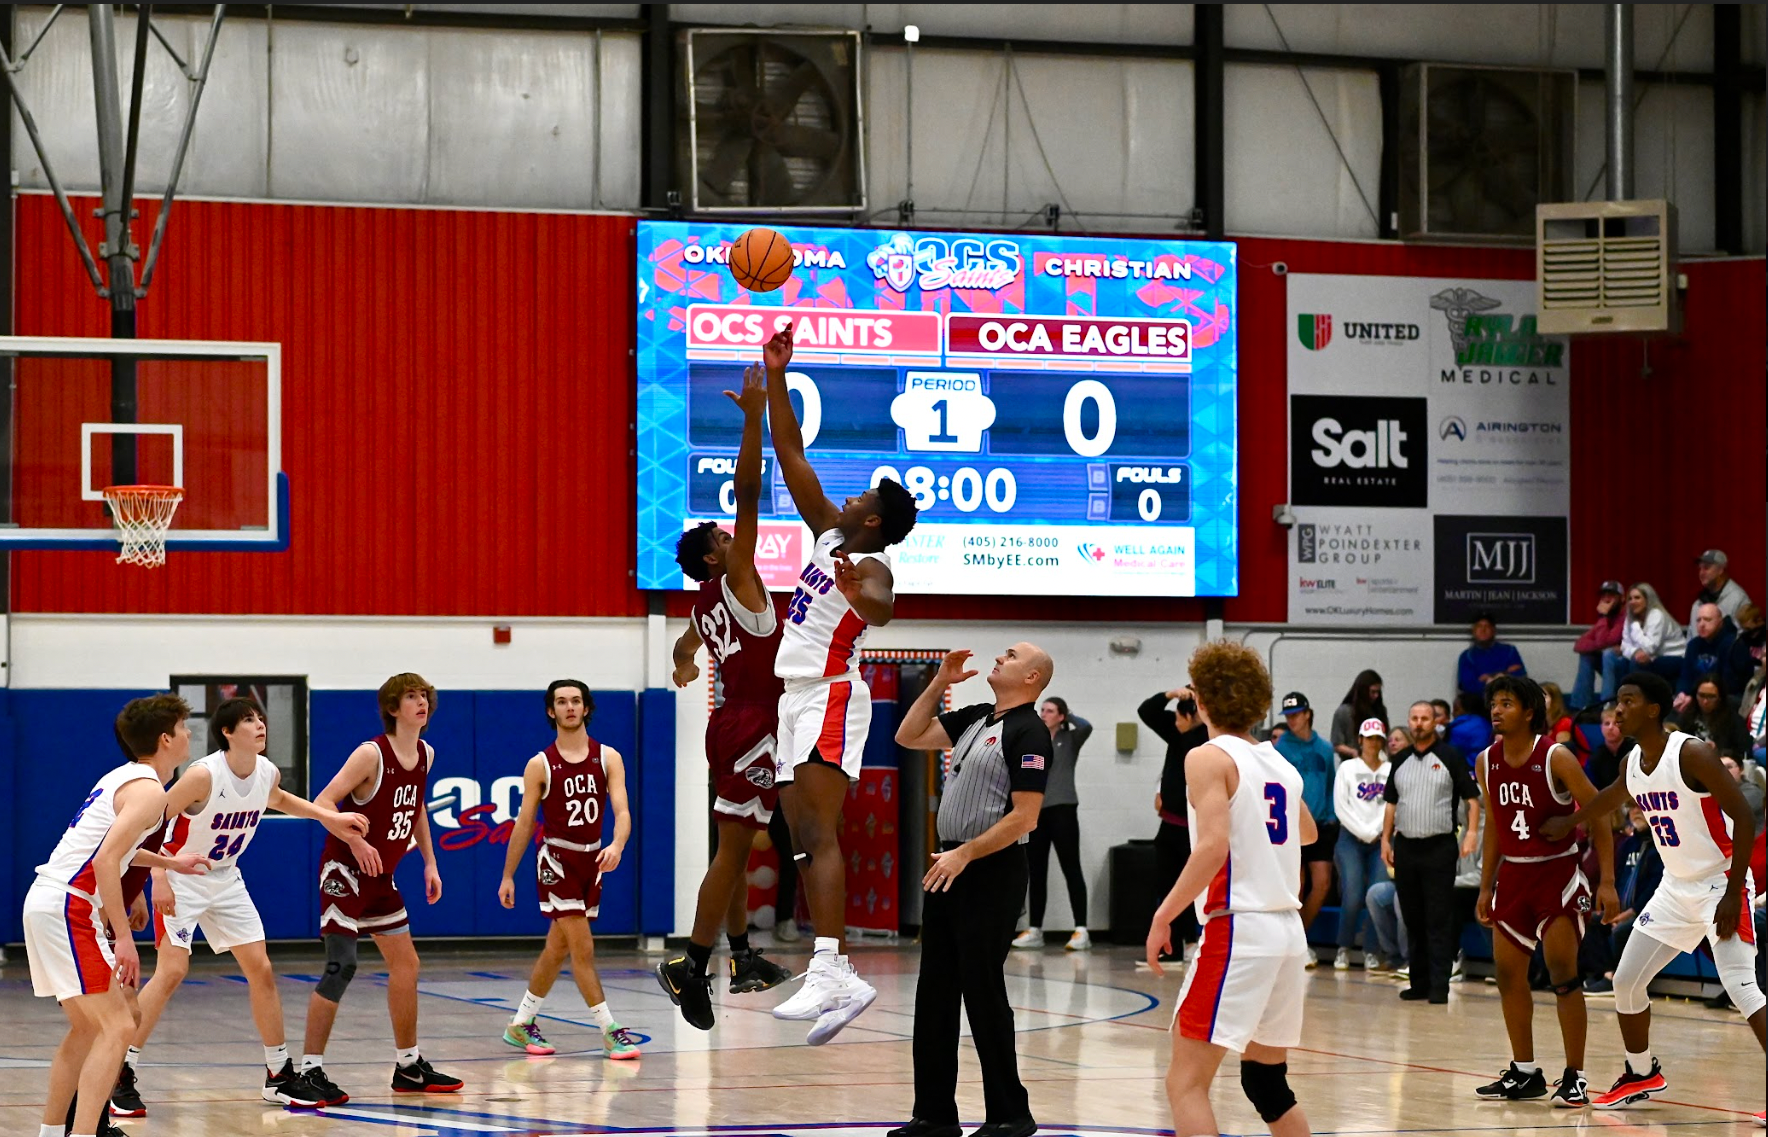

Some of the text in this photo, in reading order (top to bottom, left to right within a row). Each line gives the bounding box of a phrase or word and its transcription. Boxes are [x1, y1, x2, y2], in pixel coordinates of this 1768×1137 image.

[915, 237, 1020, 275] OCS
[919, 257, 1015, 290] Saints
[1045, 258, 1192, 279] CHRISTIAN
[693, 312, 764, 343] OCS
[978, 321, 1186, 356] OCA EAGLES
[1344, 322, 1420, 341] UNITED
[912, 378, 976, 391] PERIOD
[1441, 369, 1556, 385] MEDICAL
[929, 400, 958, 443] 1
[1063, 380, 1117, 457] 0
[1476, 421, 1562, 433] AIRINGTON
[1311, 417, 1408, 469] Salt
[1117, 467, 1182, 483] FOULS
[1324, 477, 1396, 486] REAL ESTATE
[1138, 488, 1162, 522] 0
[1319, 525, 1372, 535] WYATT
[963, 537, 1059, 549] (405) 216-8000
[1114, 545, 1185, 556] WELL AGAIN
[1302, 526, 1314, 561] WPG
[1319, 539, 1421, 551] POINDEXTER
[963, 553, 1059, 569] SMbyEE.com
[1115, 559, 1185, 568] Medical Care
[1319, 552, 1381, 564] GROUP
[1472, 541, 1530, 577] MJJ
[1445, 590, 1558, 601] MARTIN JEAN JACKSON
[1305, 606, 1414, 617] www.OKLuxuryHomes.com
[702, 602, 741, 664] 32
[394, 785, 417, 808] OCA
[564, 774, 598, 798] OCA
[1499, 782, 1534, 808] OCA
[566, 797, 599, 827] 20
[1636, 791, 1679, 811] SAINTS
[211, 810, 260, 830] SAINTS
[1264, 782, 1288, 845] 3
[1511, 810, 1530, 840] 4
[387, 810, 415, 841] 35
[208, 833, 246, 861] 24
